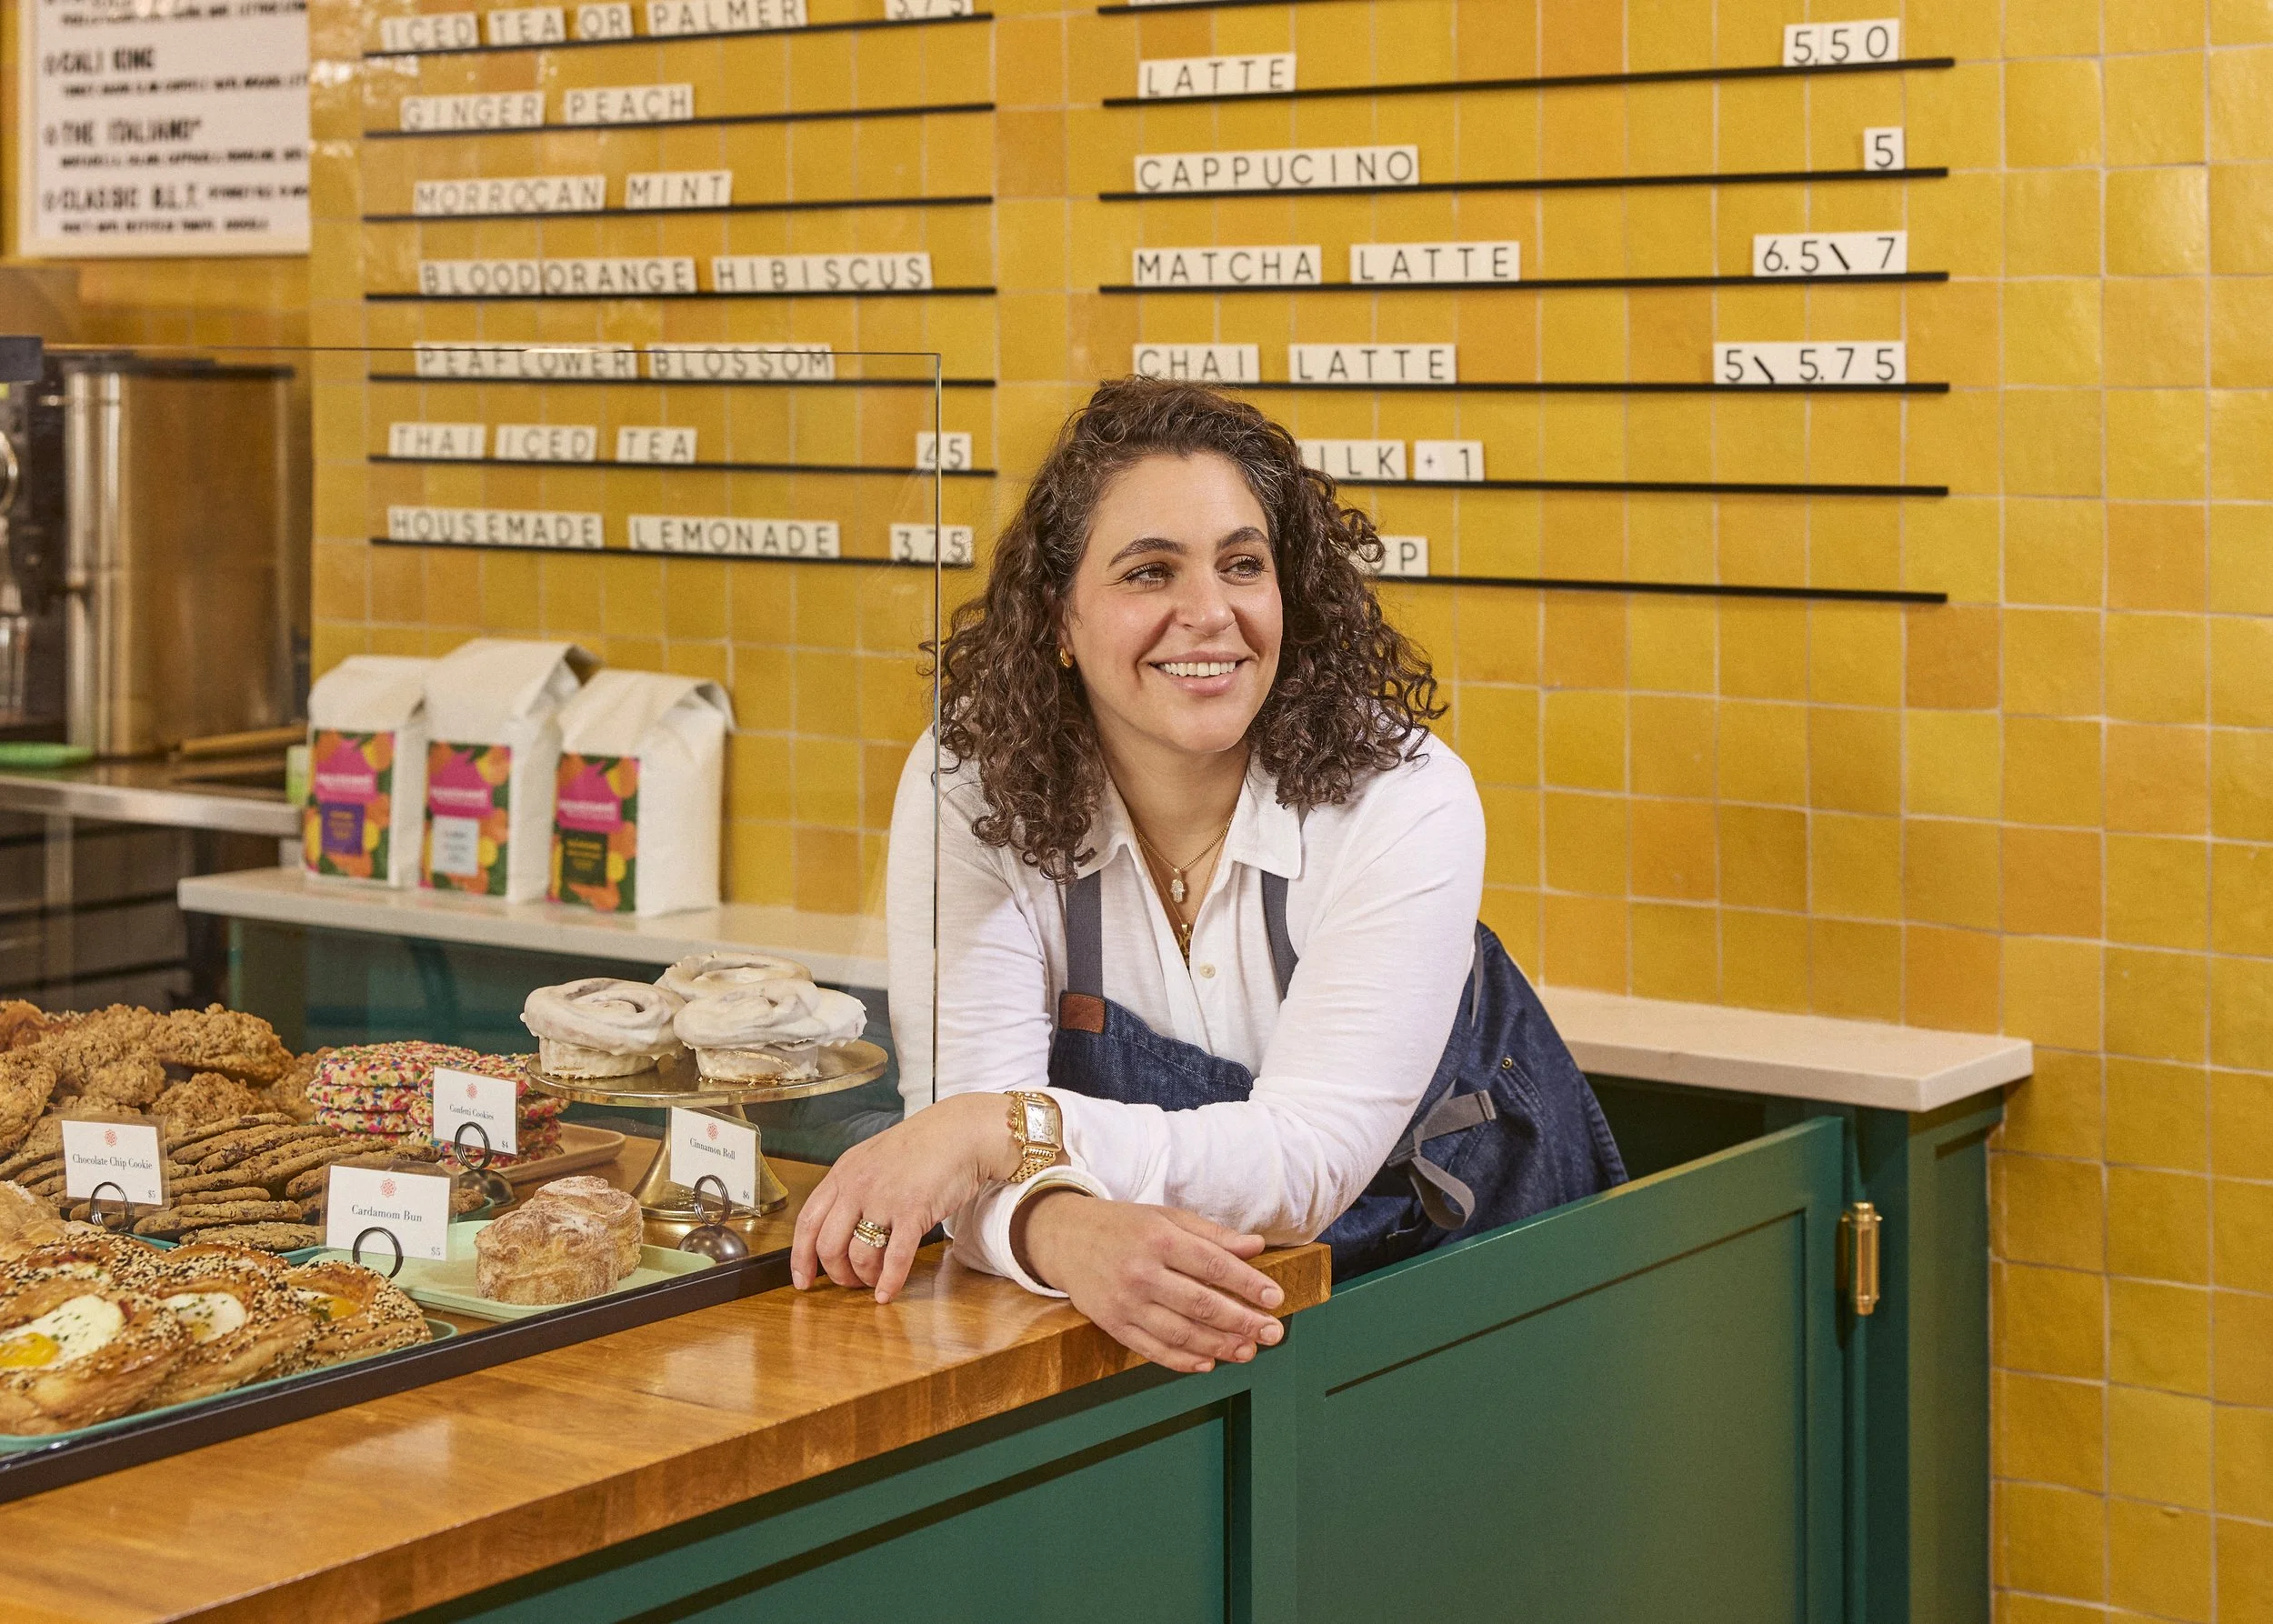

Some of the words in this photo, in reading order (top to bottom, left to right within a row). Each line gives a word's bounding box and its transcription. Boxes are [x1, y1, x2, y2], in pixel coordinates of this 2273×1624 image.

[391, 19, 471, 47] ICED
[496, 15, 559, 42] TEA
[582, 12, 624, 37] OR
[654, 1, 798, 33] PALMER
[1147, 60, 1286, 94] LATTE
[407, 98, 538, 129] GINGER
[571, 91, 686, 120] PEACH
[1874, 135, 1894, 168] 5
[1139, 151, 1414, 189] CAPPUCINO
[417, 181, 598, 212] MORROCAN
[630, 175, 724, 206] MINT
[717, 258, 924, 290] HIBISCUS
[1137, 251, 1315, 283] MATCHA
[1360, 247, 1509, 280] LATTE
[655, 346, 829, 378] BLOSSOM
[1138, 349, 1244, 378] CHAI
[1297, 349, 1447, 380] LATTE
[396, 429, 475, 456] THAI
[505, 429, 590, 458] ICED
[626, 432, 688, 460] TEA
[1297, 446, 1397, 476] ILK
[392, 512, 594, 544] HOUSEMADE
[636, 520, 831, 556] LEMONADE
[449, 1104, 471, 1117] Confetti
[473, 1109, 495, 1121] Cookies
[73, 1153, 108, 1166] Chocolate
[109, 1157, 127, 1170] Chip
[128, 1158, 153, 1169] Cookie
[689, 1138, 721, 1156] Cinnamon
[723, 1148, 736, 1161] Roll
[147, 1189, 155, 1199] $5
[351, 1204, 400, 1220] Cardamom
[404, 1209, 422, 1222] Bun
[430, 1246, 441, 1257] $5
